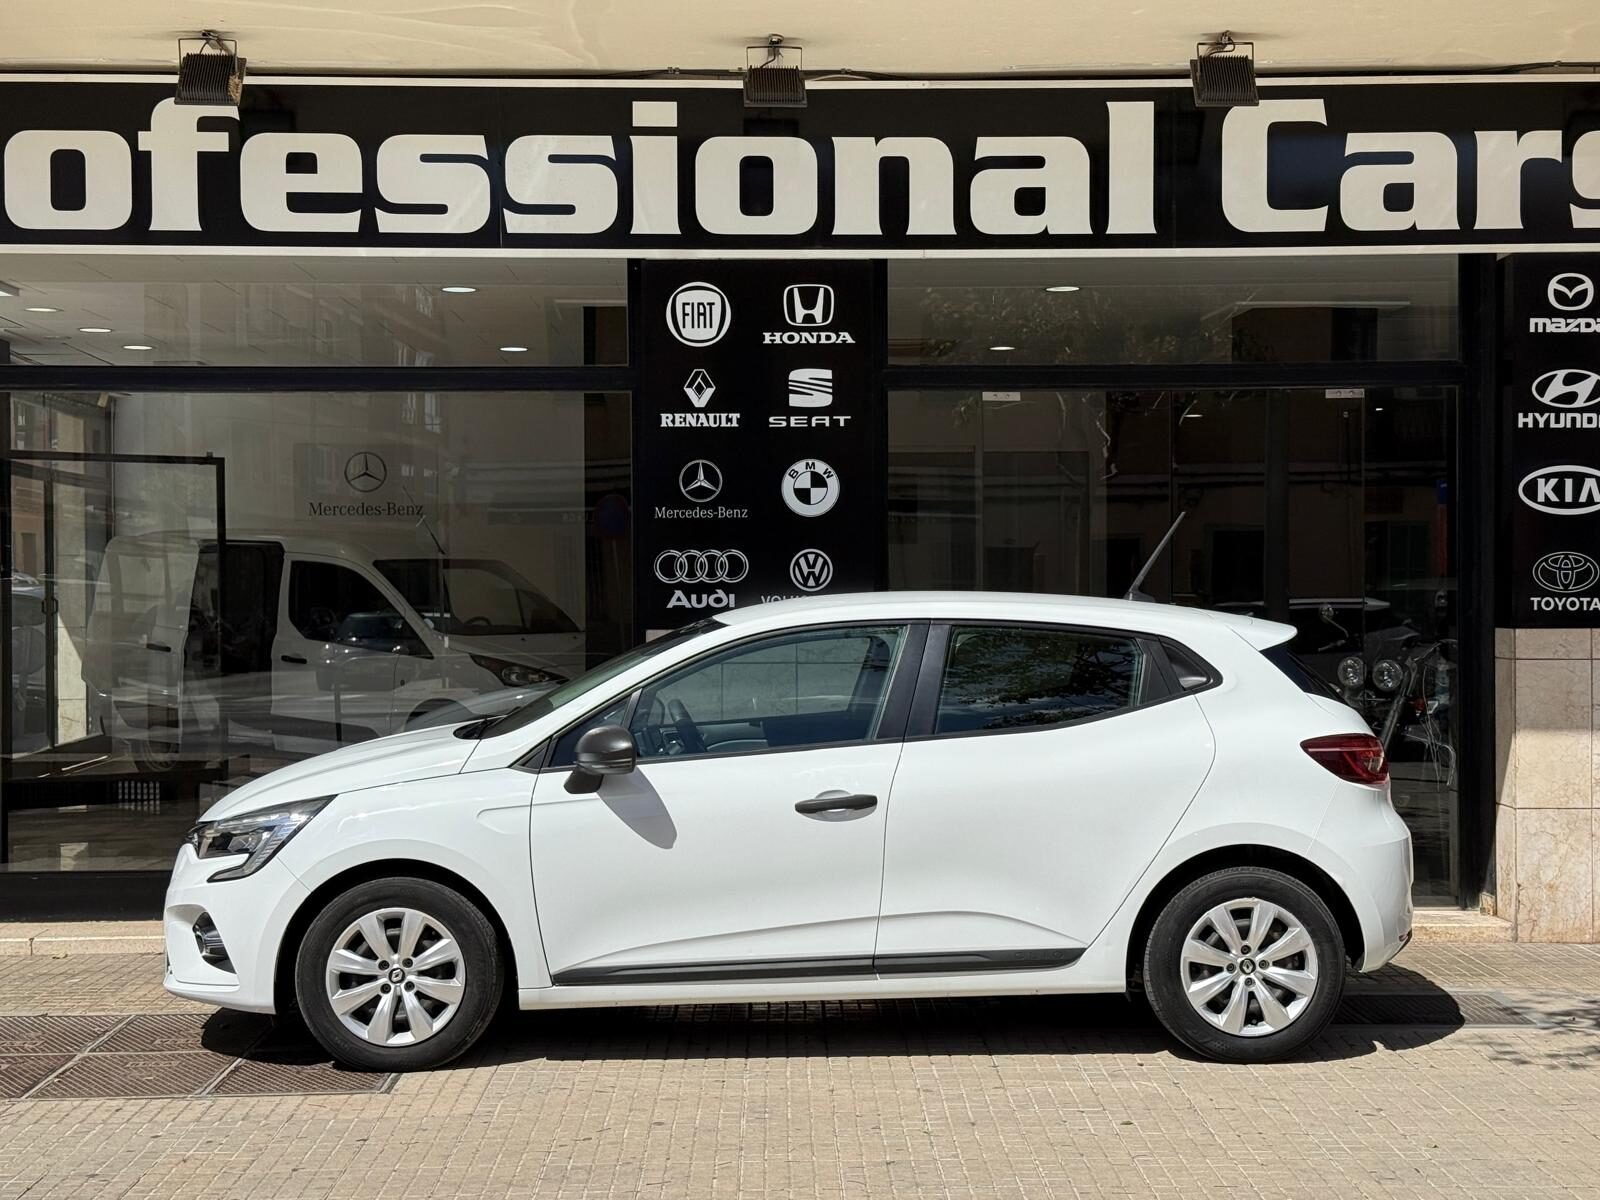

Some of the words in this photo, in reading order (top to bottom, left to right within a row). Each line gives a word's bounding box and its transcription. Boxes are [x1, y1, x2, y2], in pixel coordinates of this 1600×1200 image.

[1221, 98, 1600, 232] Car
[681, 302, 716, 329] FIAT
[762, 331, 856, 345] HONDA
[660, 413, 741, 428] RENAULT
[768, 415, 852, 428] SEAT
[1517, 412, 1600, 429] HYUND
[788, 461, 834, 480] BMW
[1537, 477, 1600, 503] KIA
[308, 501, 424, 517] Mercedes-Benz
[654, 506, 749, 519] Mercedes-Benz
[666, 588, 736, 609] Audi
[1530, 596, 1600, 611] TOYOTA
